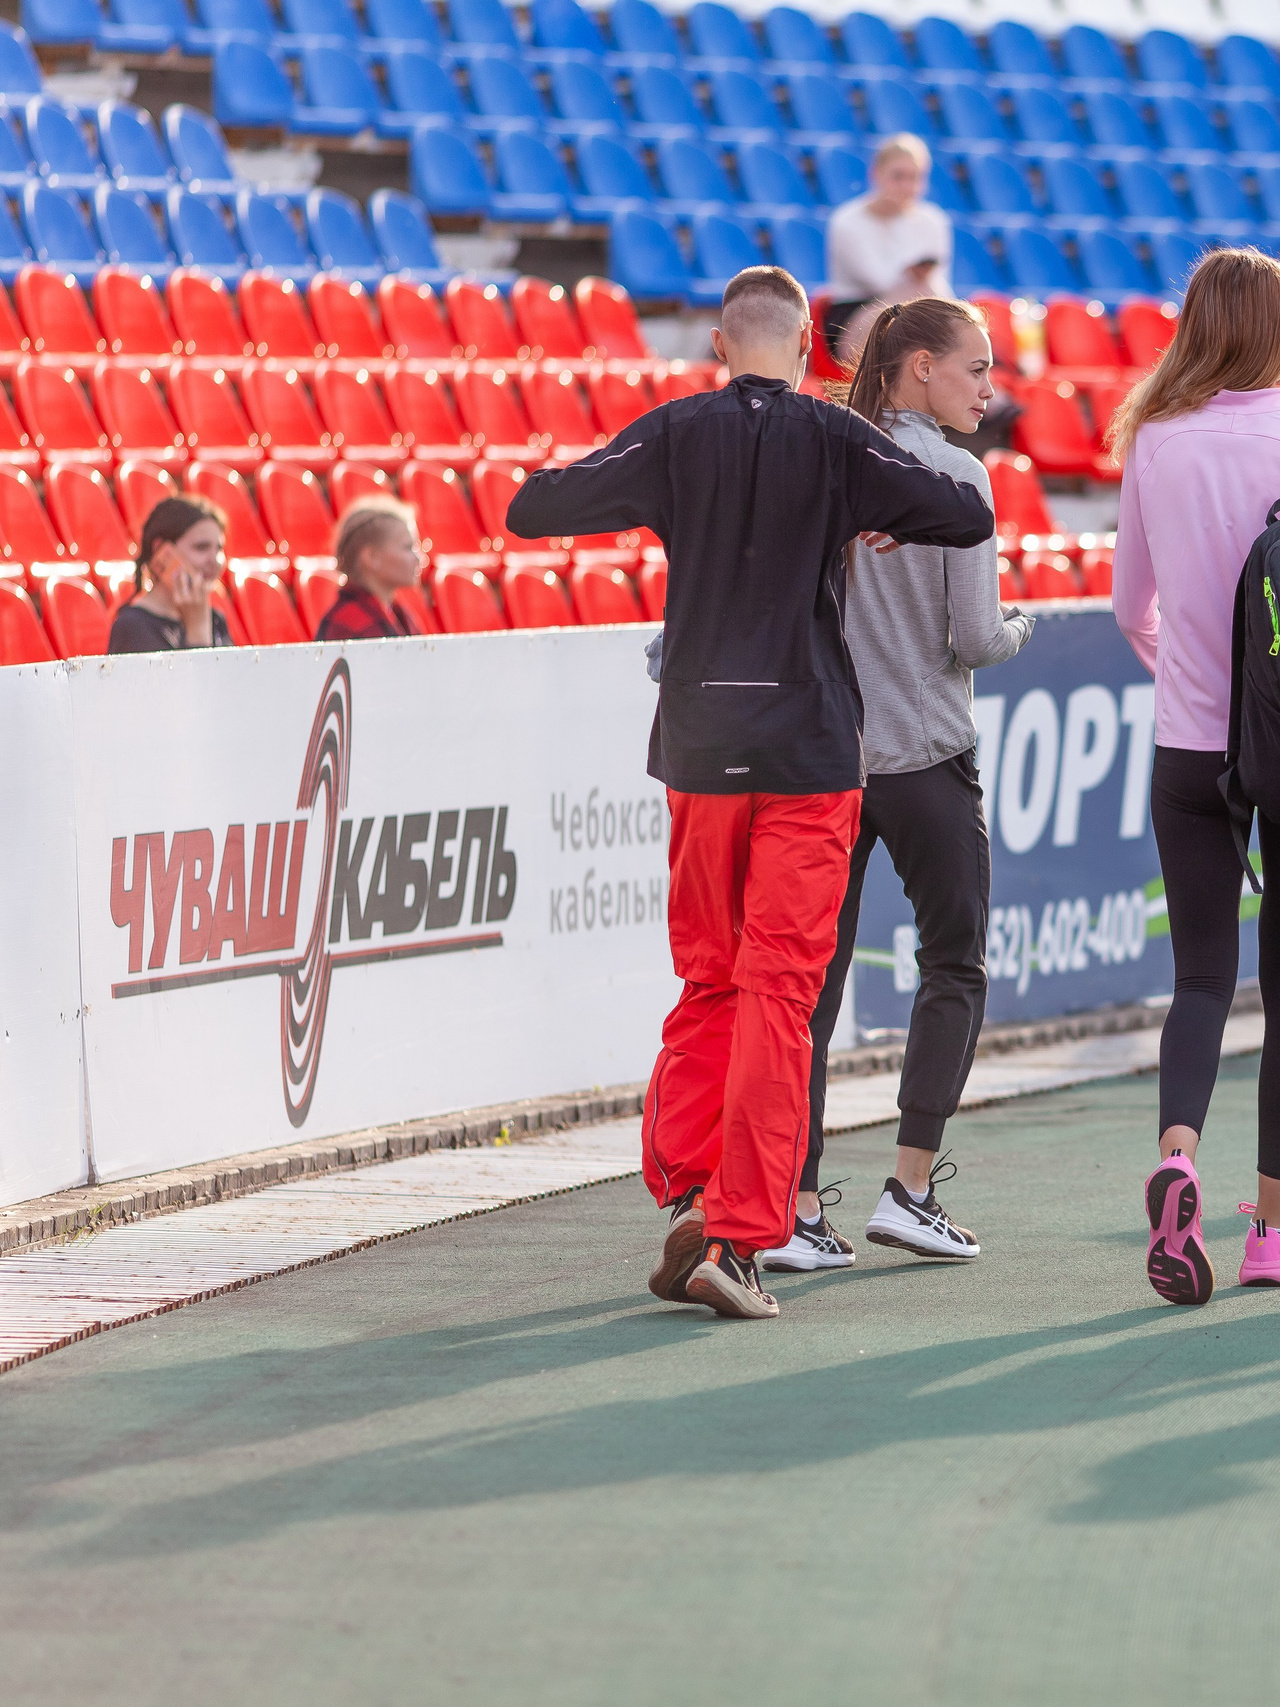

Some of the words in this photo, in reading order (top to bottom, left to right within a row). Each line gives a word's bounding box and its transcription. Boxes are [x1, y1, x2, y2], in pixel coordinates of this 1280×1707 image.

[551, 787, 671, 852] Чебокса
[109, 818, 309, 974] ЧУВАШ
[328, 804, 519, 945] КАБЕЛЬ
[550, 866, 670, 934] кабельн
